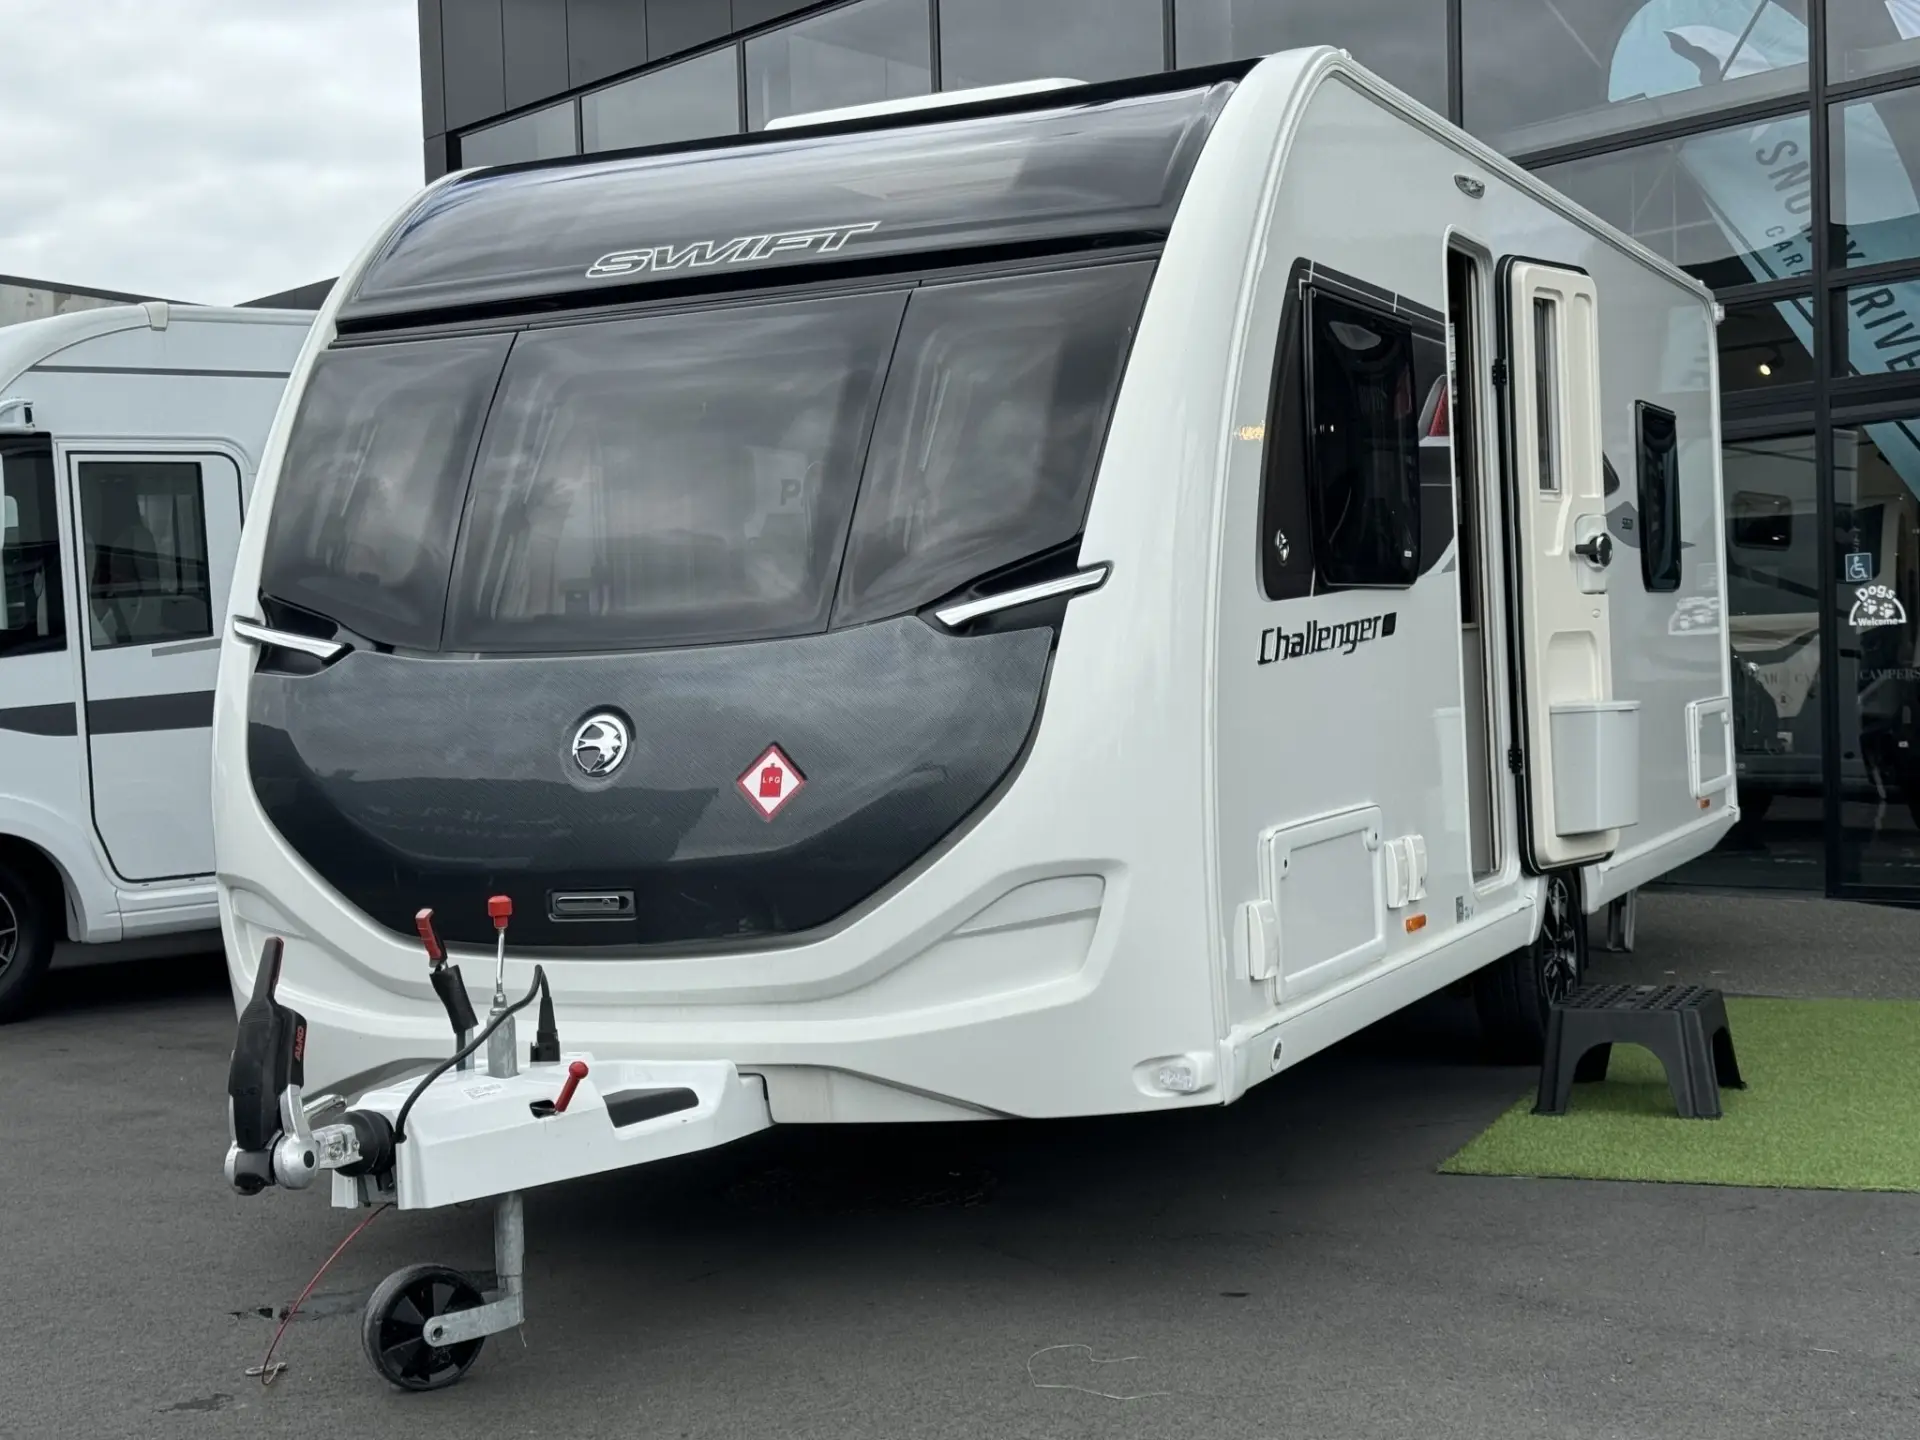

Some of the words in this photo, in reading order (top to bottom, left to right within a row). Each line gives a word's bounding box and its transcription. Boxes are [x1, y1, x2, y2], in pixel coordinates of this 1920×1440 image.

[585, 220, 882, 278] SWIFT
[1855, 585, 1896, 601] Dogs
[1857, 617, 1898, 626] Welcome
[1257, 615, 1382, 665] Challenger
[762, 776, 781, 784] LPG
